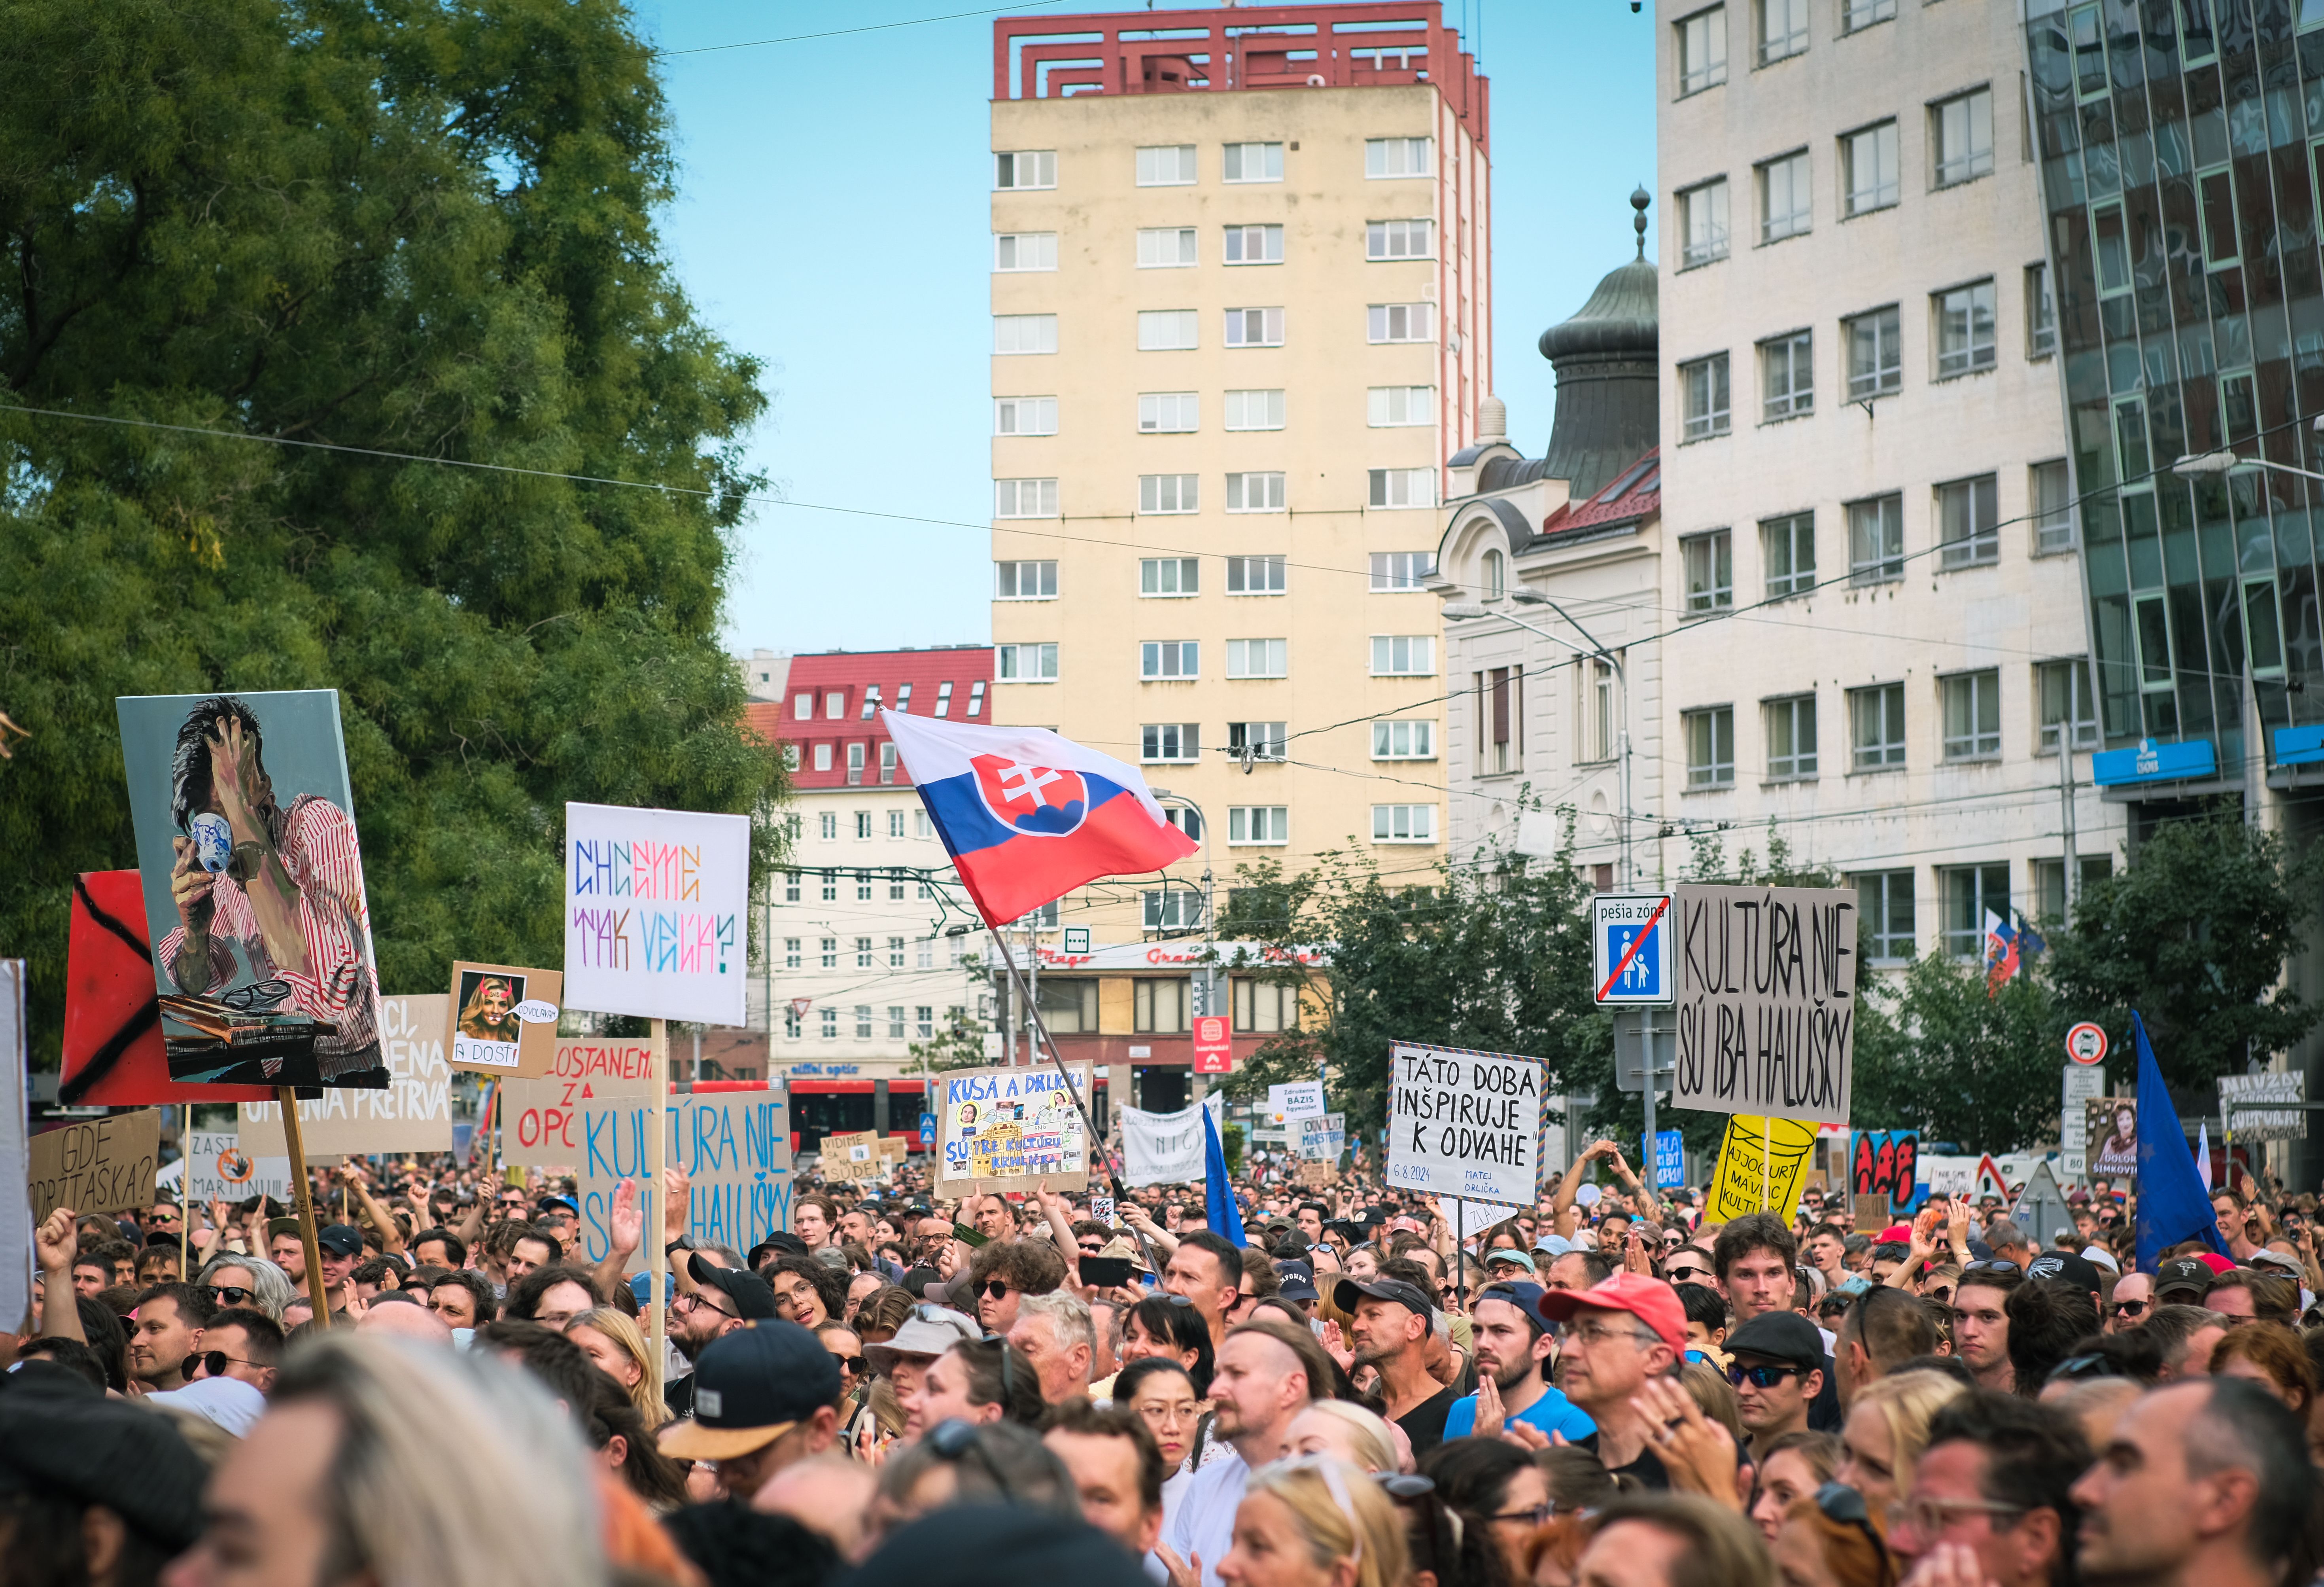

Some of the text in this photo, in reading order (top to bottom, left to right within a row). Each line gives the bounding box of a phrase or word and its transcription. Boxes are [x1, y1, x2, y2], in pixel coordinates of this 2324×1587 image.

[1601, 903, 1665, 921] pešia zóna
[574, 907, 630, 972] TAK
[1684, 891, 1855, 1000] KULTÚRA NIE
[384, 999, 418, 1039] CI,
[455, 1043, 464, 1059] A
[1679, 993, 1706, 1096] SÚ
[1713, 1003, 1748, 1102] IBA
[545, 1046, 652, 1079] OSTANEM
[791, 1063, 860, 1076] eiffel optic
[948, 1075, 998, 1104] KUSÁ
[1006, 1077, 1019, 1097] A
[1473, 1063, 1536, 1097] DOBA
[559, 1083, 594, 1107] ZA
[1288, 1095, 1314, 1105] BÁZIS
[1397, 1086, 1519, 1131] INŠPIRUJE
[62, 1120, 112, 1173] GDE
[192, 1137, 238, 1155] ZAST
[745, 1103, 787, 1174] NIE
[945, 1135, 1061, 1163] SÚ PRE KULTÚRU
[1412, 1121, 1427, 1153] K
[1728, 1146, 1798, 1179] AJ JOGURT
[2070, 1159, 2083, 1168] 80
[2104, 1154, 2137, 1163] DOLOR
[1394, 1164, 1492, 1182] 6.8.2024 MATEJ
[27, 1155, 152, 1227] ODRŽTAŠKA?
[1465, 1182, 1500, 1195] DRLIČKA
[1722, 1188, 1781, 1215] KULTÚY
[1279, 1273, 1307, 1286] MPOWER
